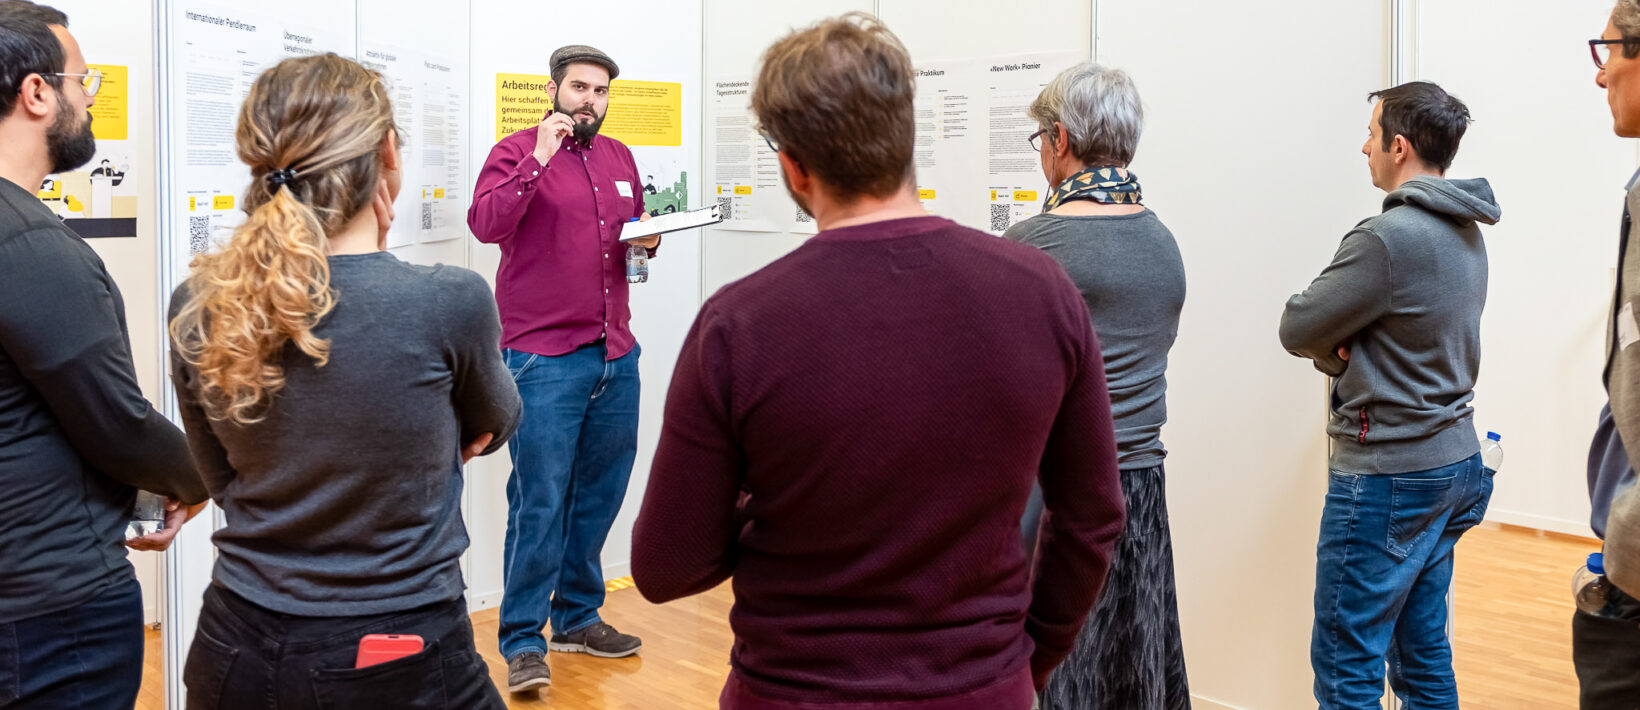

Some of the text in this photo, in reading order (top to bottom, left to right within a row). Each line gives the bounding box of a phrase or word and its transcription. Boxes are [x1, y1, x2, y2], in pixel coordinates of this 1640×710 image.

[186, 9, 257, 32] Internationaler Pendlerraum
[1021, 62, 1041, 70] Pionier
[920, 68, 945, 77] Praktikum
[518, 96, 549, 104] schaffen
[501, 107, 542, 115] gemeinsam
[501, 116, 541, 125] Arbeitsplat
